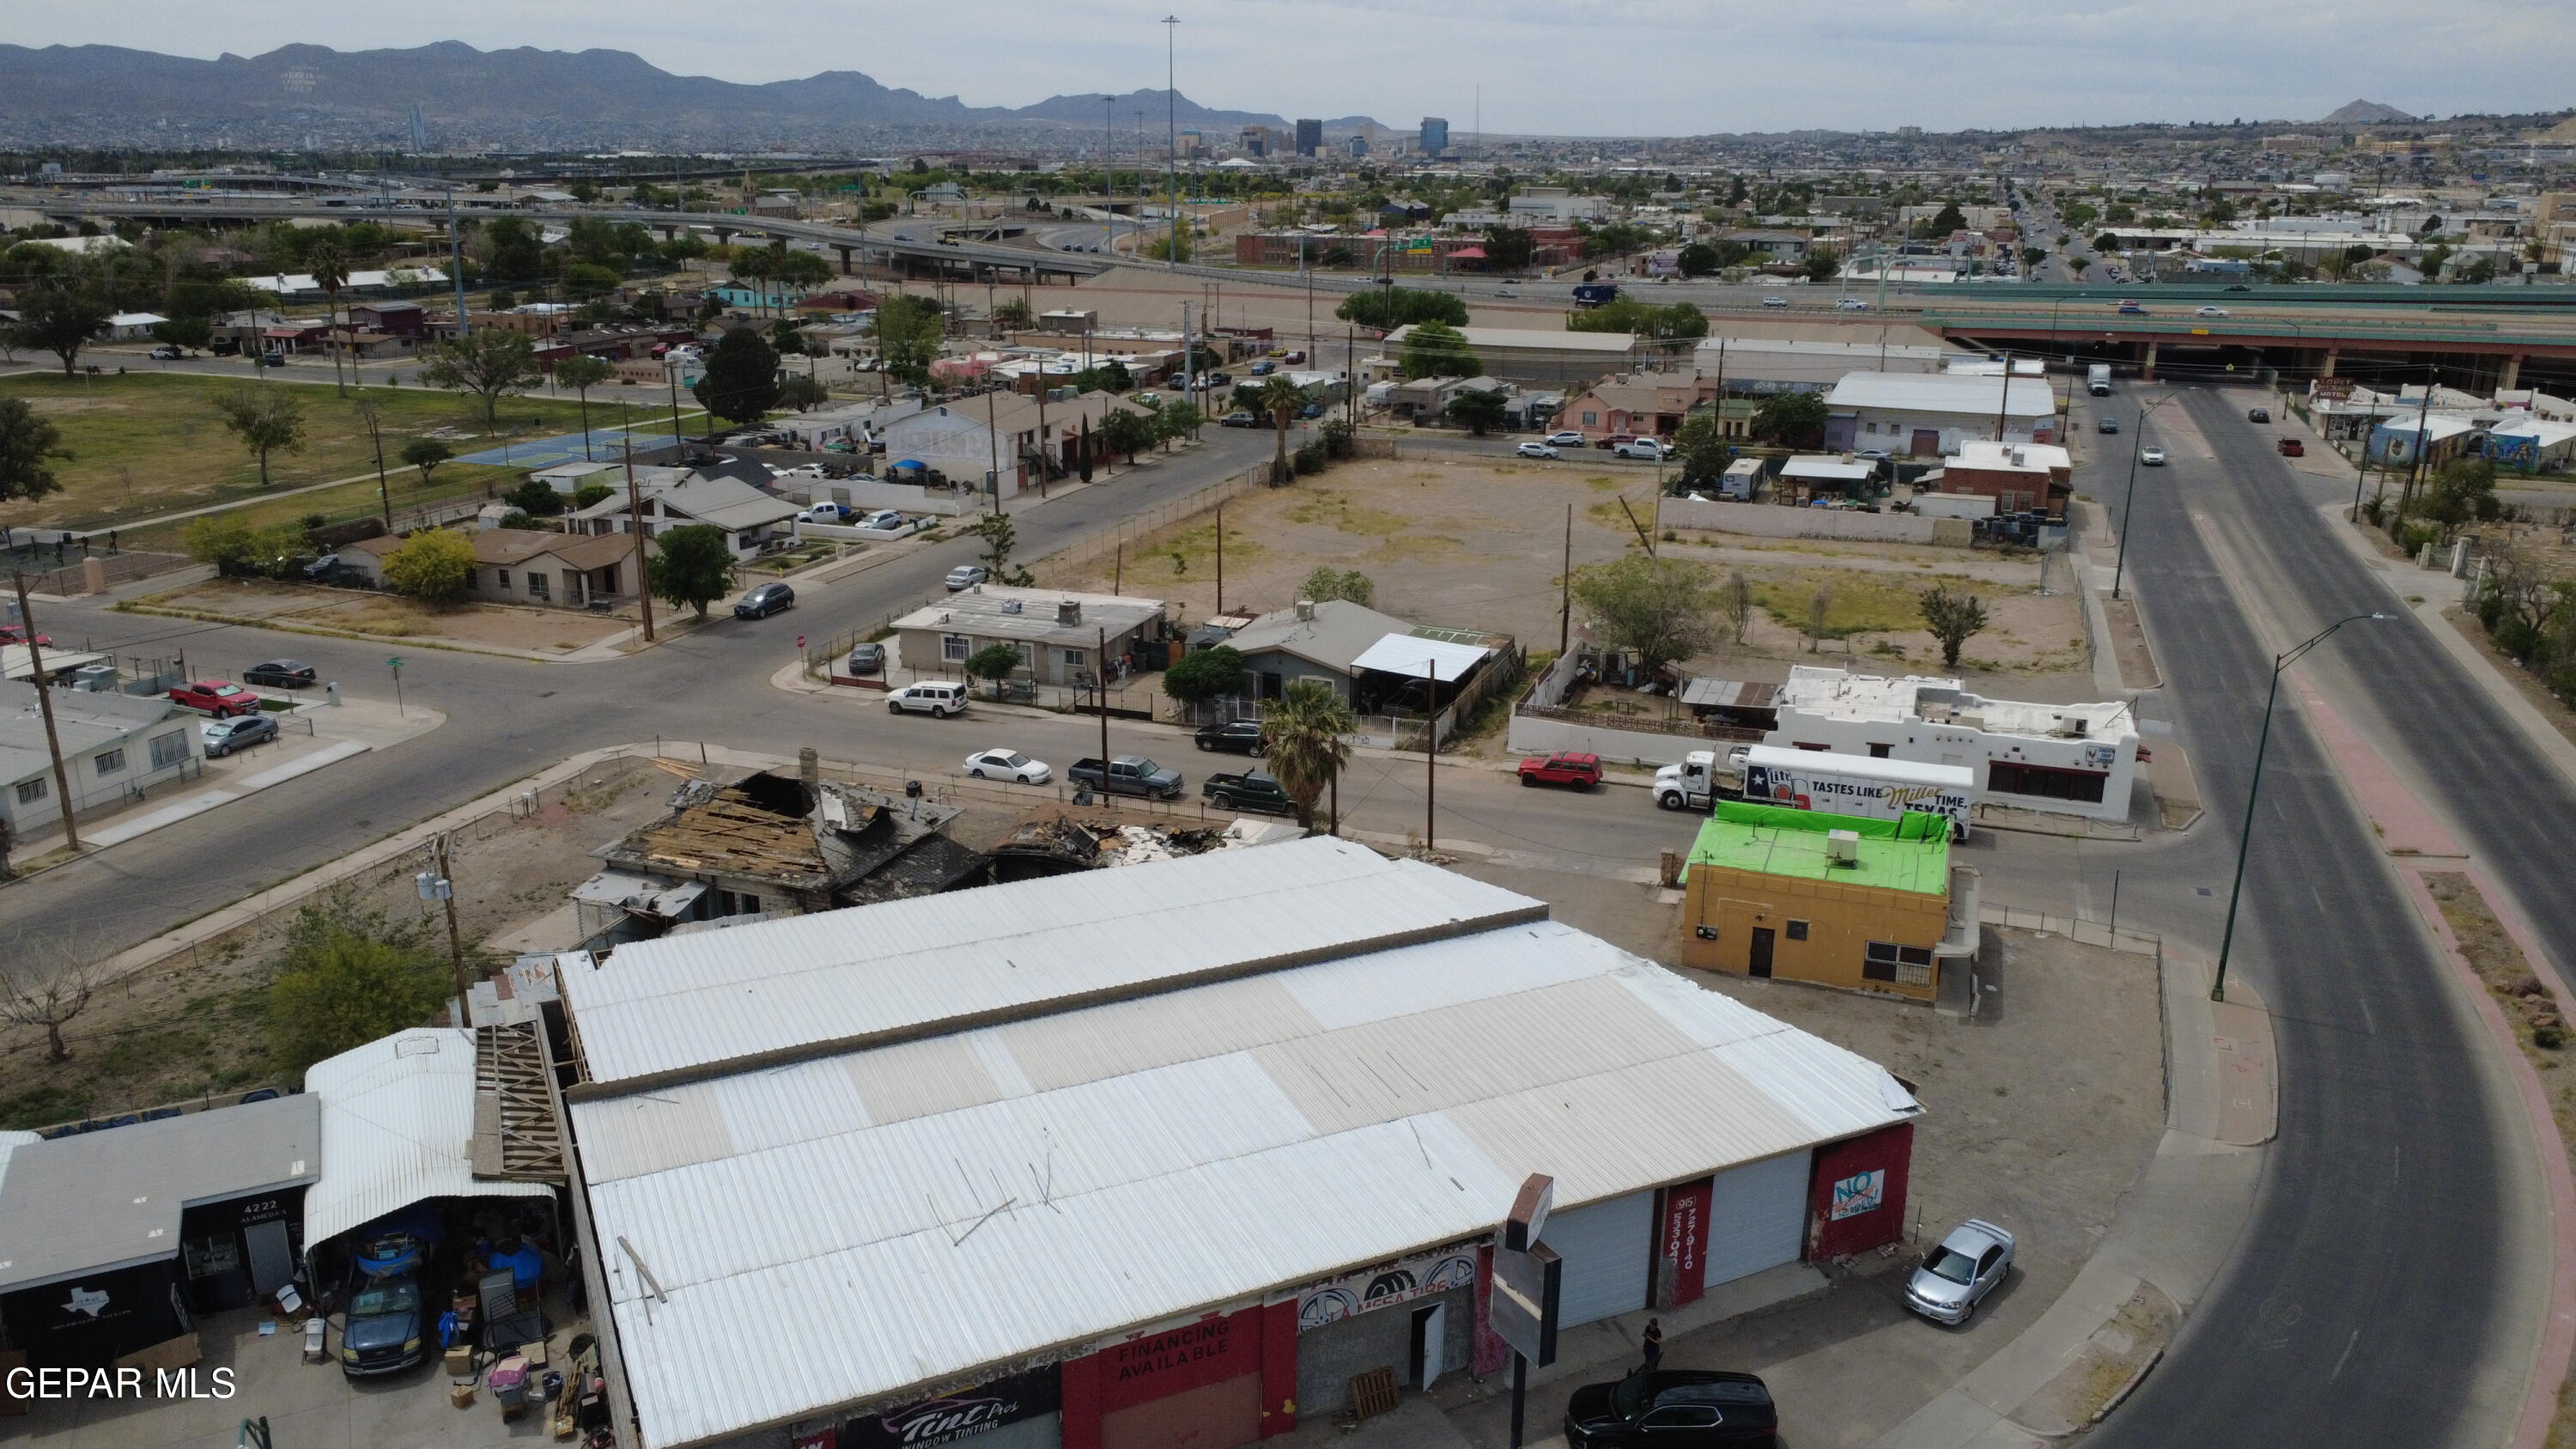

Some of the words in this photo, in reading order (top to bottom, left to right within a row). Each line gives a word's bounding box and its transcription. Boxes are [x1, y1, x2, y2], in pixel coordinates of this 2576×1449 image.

[1771, 770, 1790, 784] Lite
[1812, 782, 1854, 795] TASTES
[1856, 786, 1882, 798] LIKE
[1881, 785, 1945, 808] Miller
[1935, 795, 1968, 809] TIME,
[1905, 803, 1958, 819] TEXAS
[1836, 1171, 1871, 1202] NO
[244, 1200, 277, 1214] 4222
[1676, 1196, 1697, 1210] (915)
[1119, 1320, 1230, 1362] FINANCING
[1118, 1338, 1229, 1381] AVAILABLE
[902, 1404, 988, 1442] Tint
[987, 1401, 1019, 1419] Pros
[955, 1419, 999, 1440] TINTING
